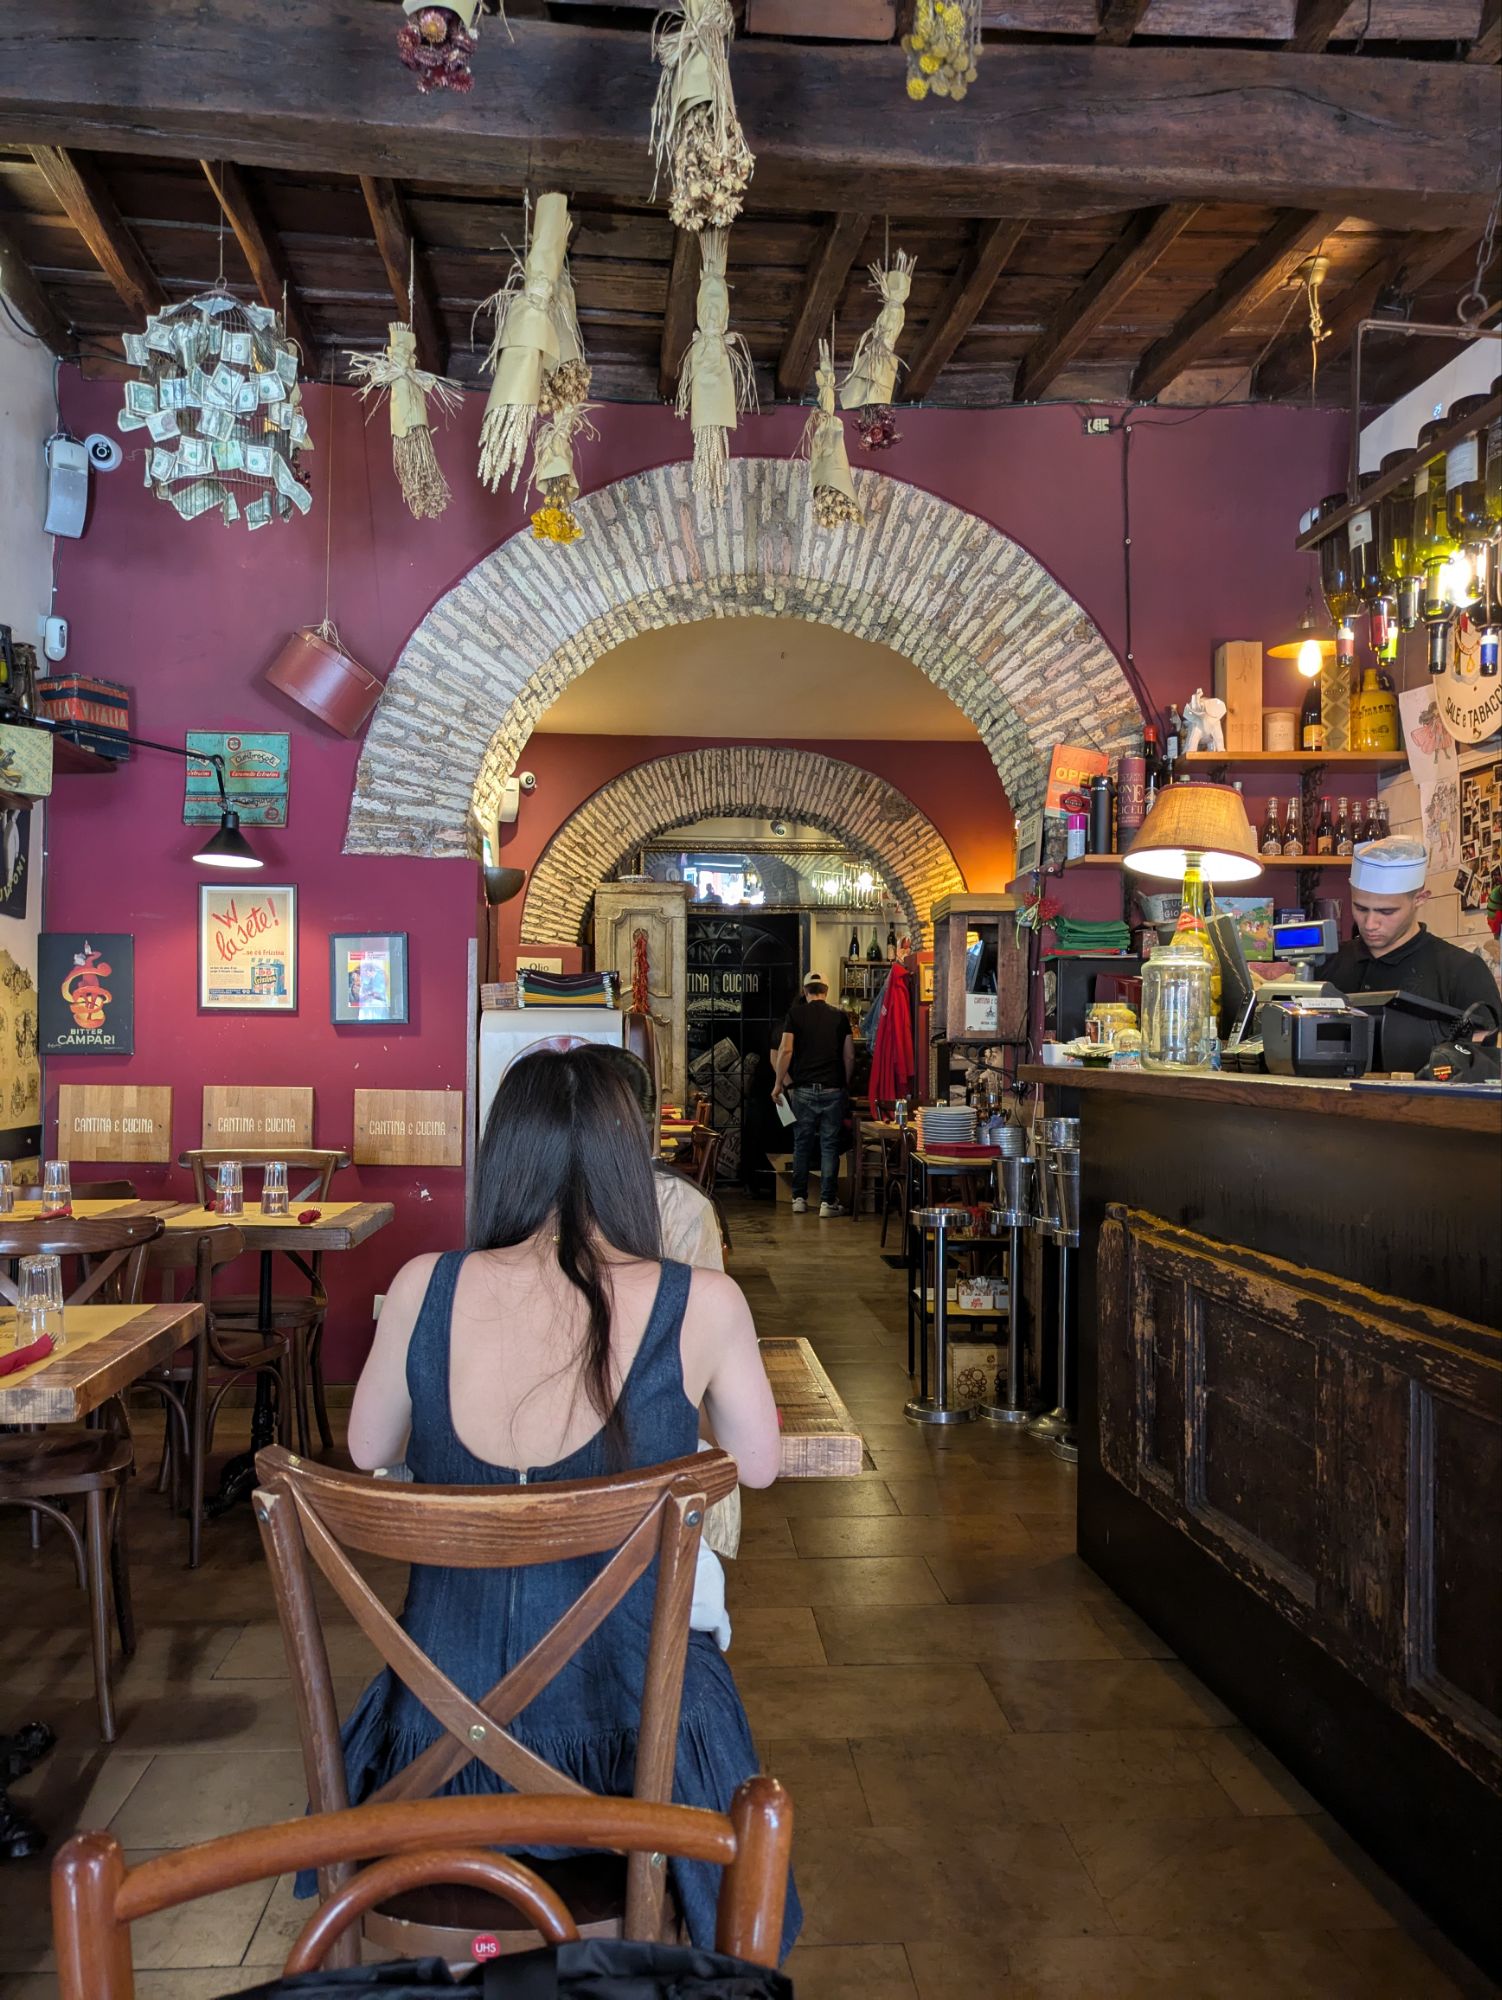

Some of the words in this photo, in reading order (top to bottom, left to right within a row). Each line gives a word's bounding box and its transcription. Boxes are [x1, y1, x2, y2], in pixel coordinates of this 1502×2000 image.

[81, 702, 127, 727] VITALIA
[1445, 697, 1461, 726] SALE
[1055, 767, 1093, 785] OPE
[216, 930, 245, 961] la
[722, 973, 759, 993] CUCINA
[57, 1034, 116, 1045] CAMPARI
[74, 1116, 112, 1133] CANTINA
[122, 1117, 153, 1134] CUCINA
[217, 1116, 255, 1133] CANTINA
[265, 1117, 296, 1133] CUCINA
[369, 1120, 406, 1135] CANTINA
[415, 1121, 446, 1136] CUCINA
[475, 1942, 497, 1953] UHS
